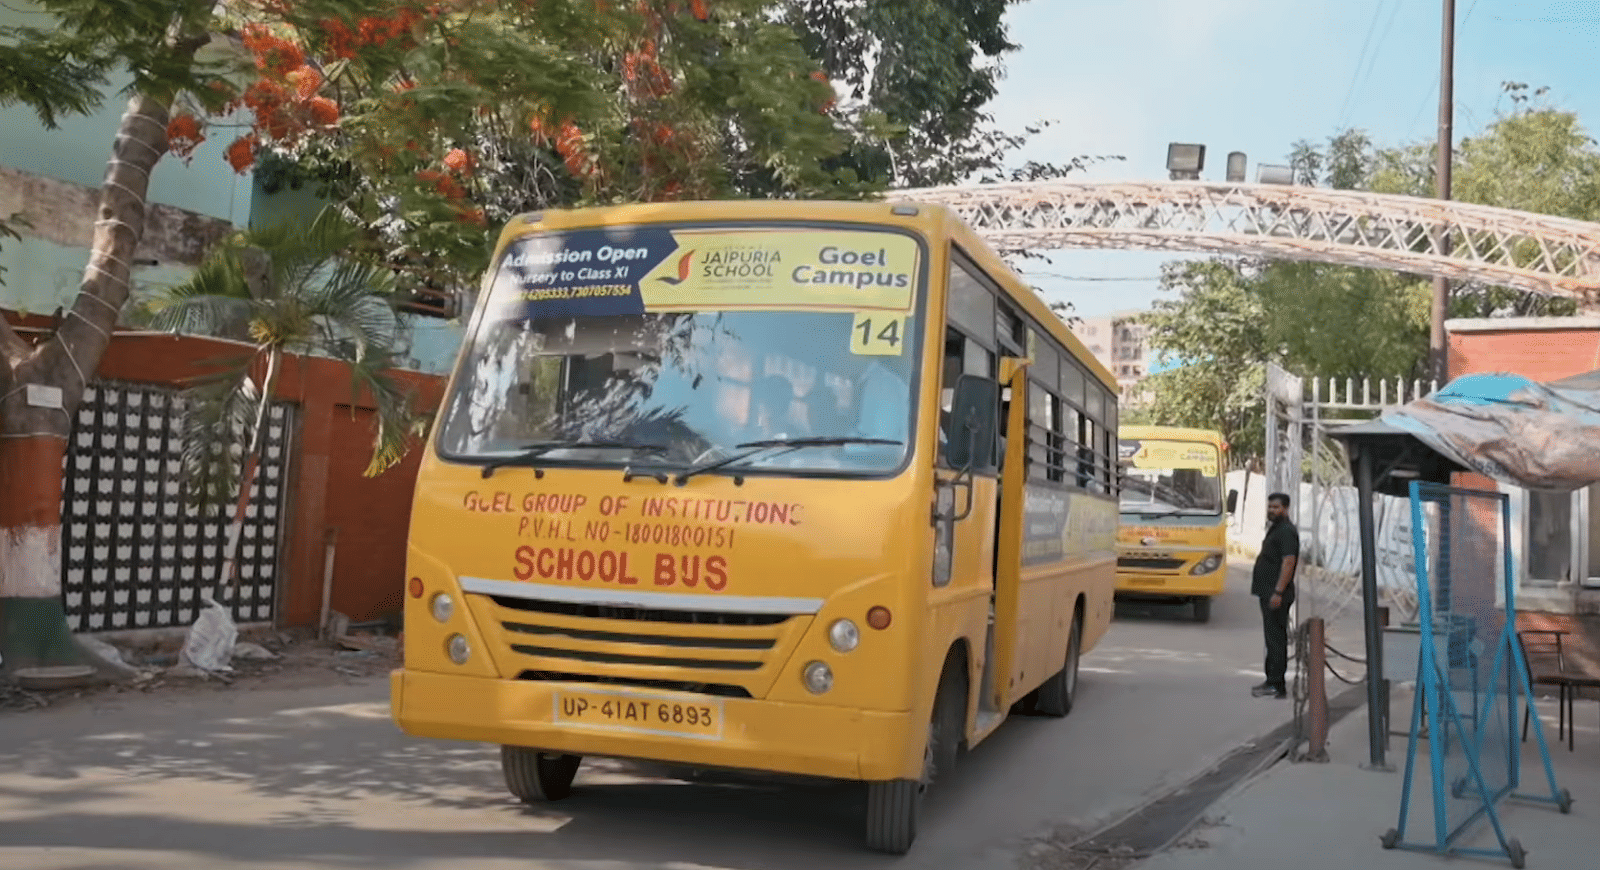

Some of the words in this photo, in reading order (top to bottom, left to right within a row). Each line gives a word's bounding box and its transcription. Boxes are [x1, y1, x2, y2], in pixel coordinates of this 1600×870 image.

[597, 246, 648, 264] Open
[701, 250, 782, 265] JAIPURIA
[818, 246, 886, 267] Goel
[560, 270, 575, 281] to
[577, 267, 612, 280] Class
[613, 266, 629, 279] XI
[702, 263, 774, 278] SCHOOL
[792, 265, 908, 289] Campus
[855, 317, 900, 347] 14
[522, 492, 587, 513] GROUP
[599, 495, 629, 516] OF
[513, 545, 638, 585] SCHOOL
[654, 553, 727, 591] BUS
[564, 697, 650, 721] UP-41AT
[657, 703, 712, 727] 6893
